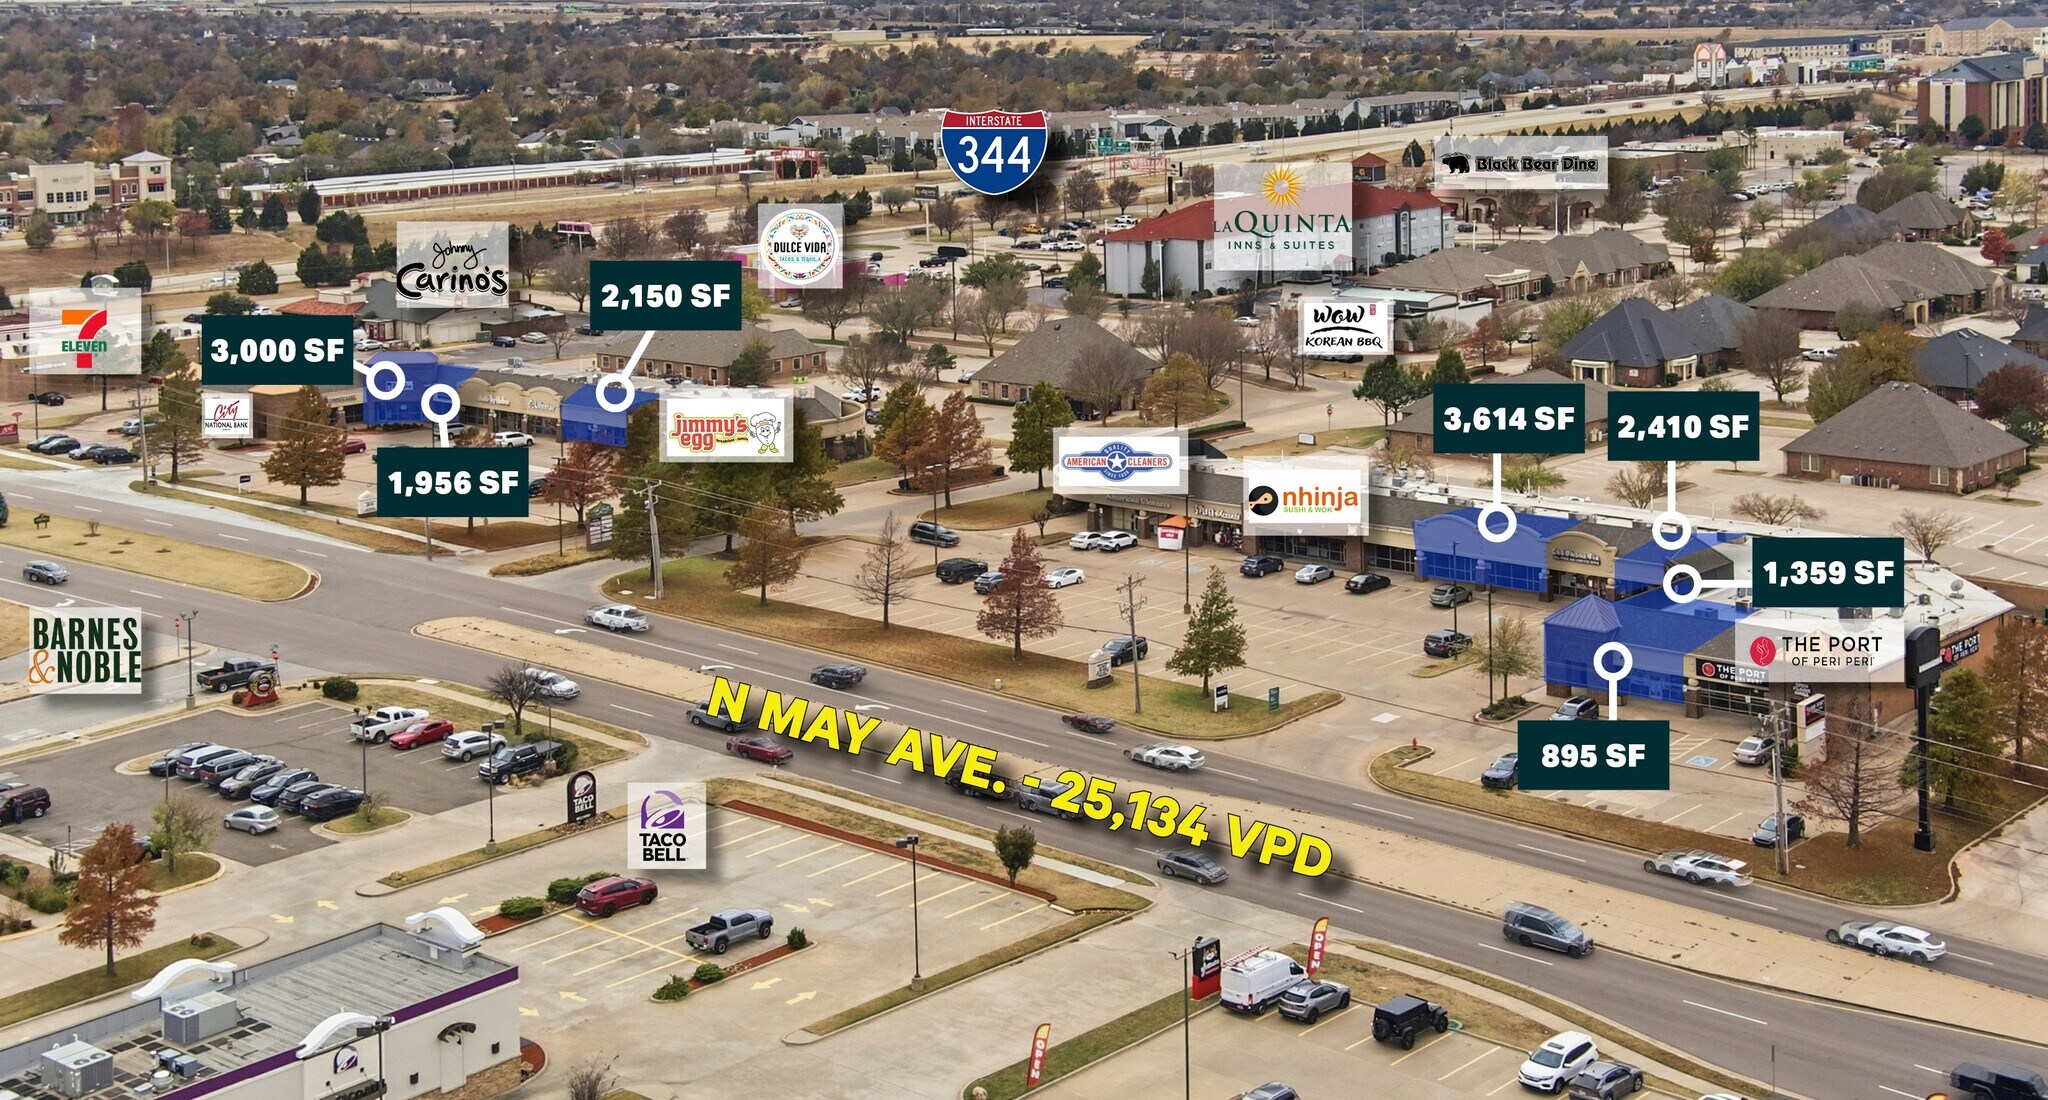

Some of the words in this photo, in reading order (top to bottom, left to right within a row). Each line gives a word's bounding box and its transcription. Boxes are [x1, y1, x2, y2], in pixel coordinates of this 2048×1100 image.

[1952, 642, 1963, 655] THE
[1964, 634, 1980, 649] PORT
[1717, 664, 1736, 675] THE
[1739, 667, 1767, 680] PORT
[573, 794, 595, 806] TACO
[575, 801, 595, 813] BELL
[1311, 933, 1325, 968] OPEN
[1030, 1040, 1046, 1079] OPEN
